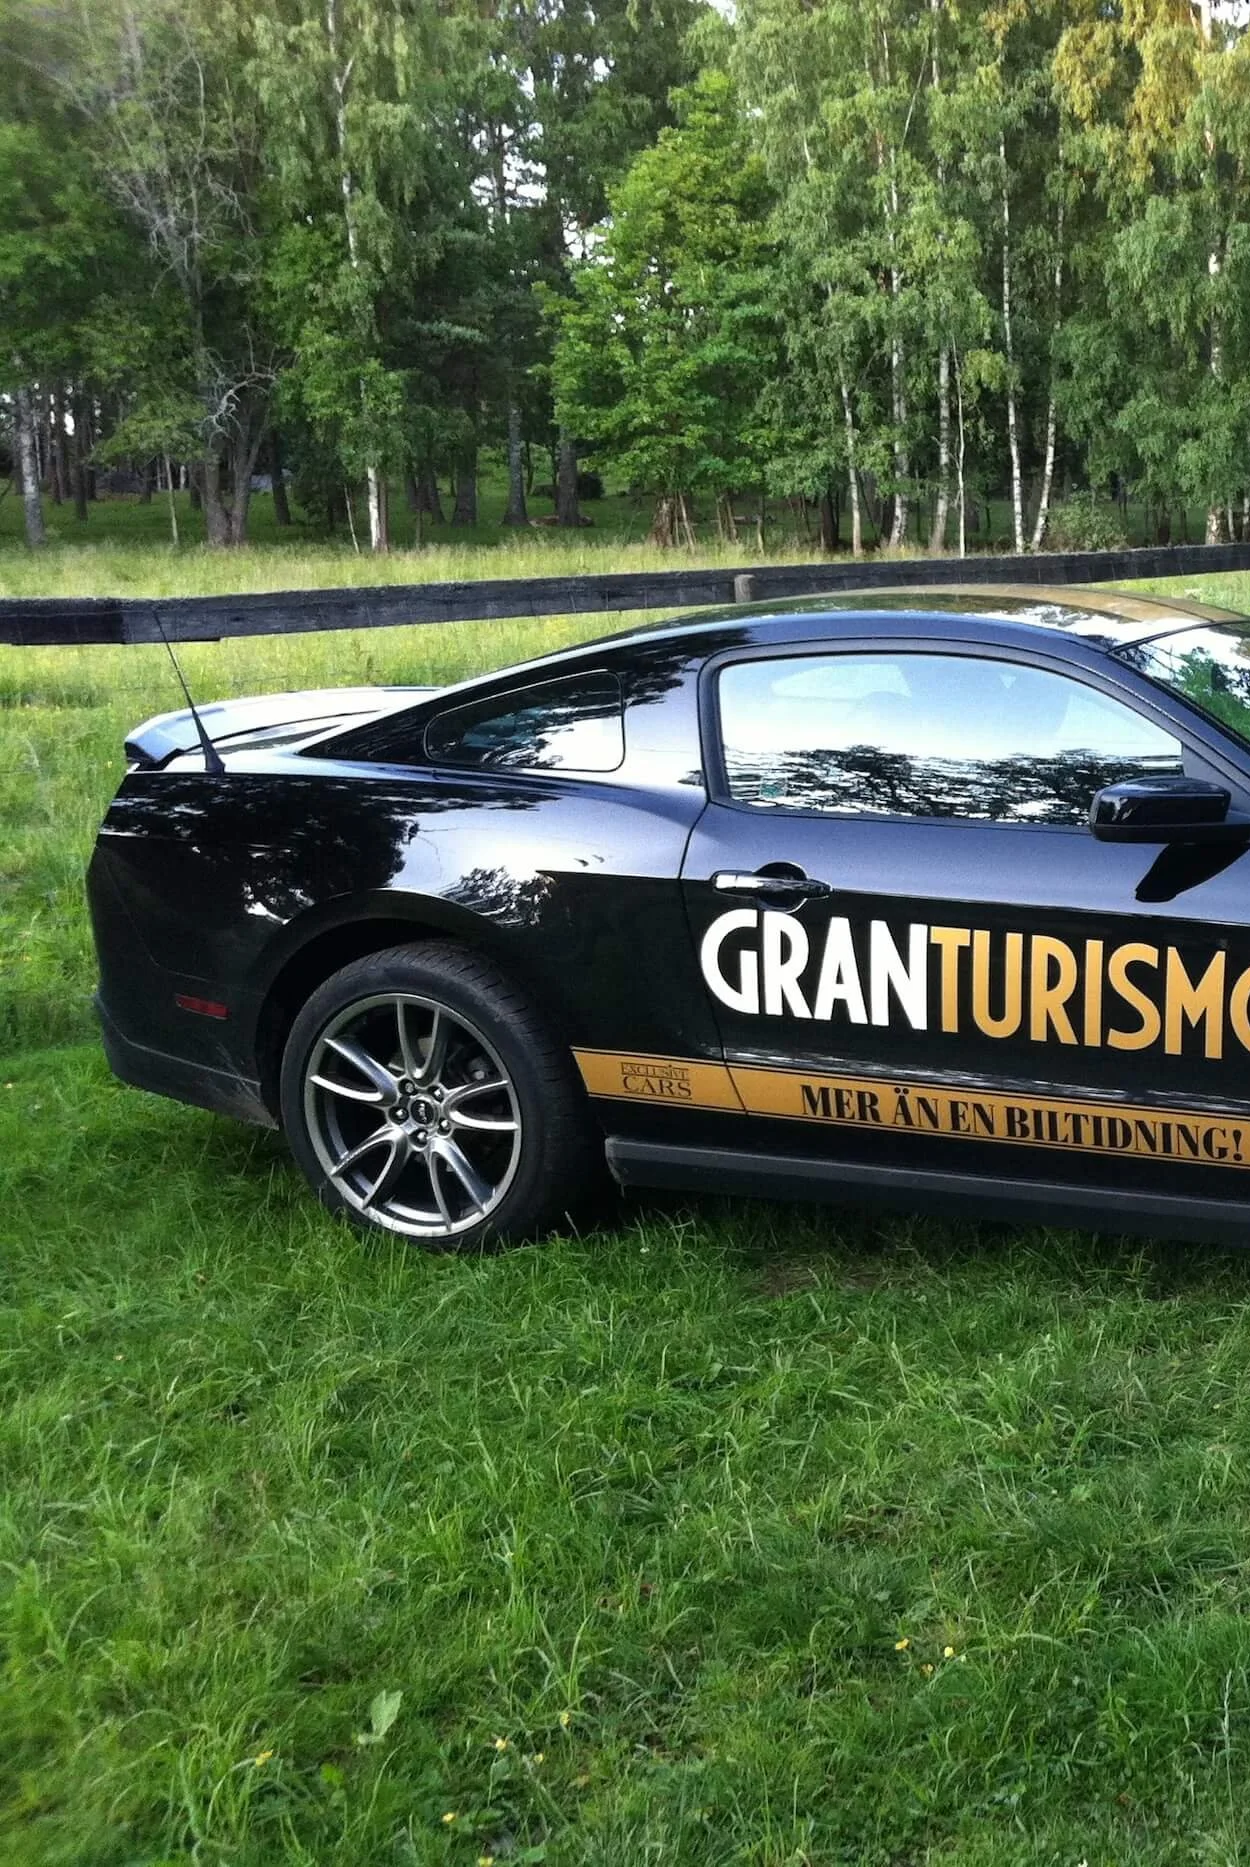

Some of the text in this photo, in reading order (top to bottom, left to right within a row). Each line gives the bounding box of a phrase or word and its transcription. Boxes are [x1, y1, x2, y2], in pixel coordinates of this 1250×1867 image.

[621, 1062, 690, 1081] EXCLUSIVE
[622, 1076, 692, 1099] CARS
[800, 1084, 1243, 1162] MER ÄN EN BILTIDNING!
